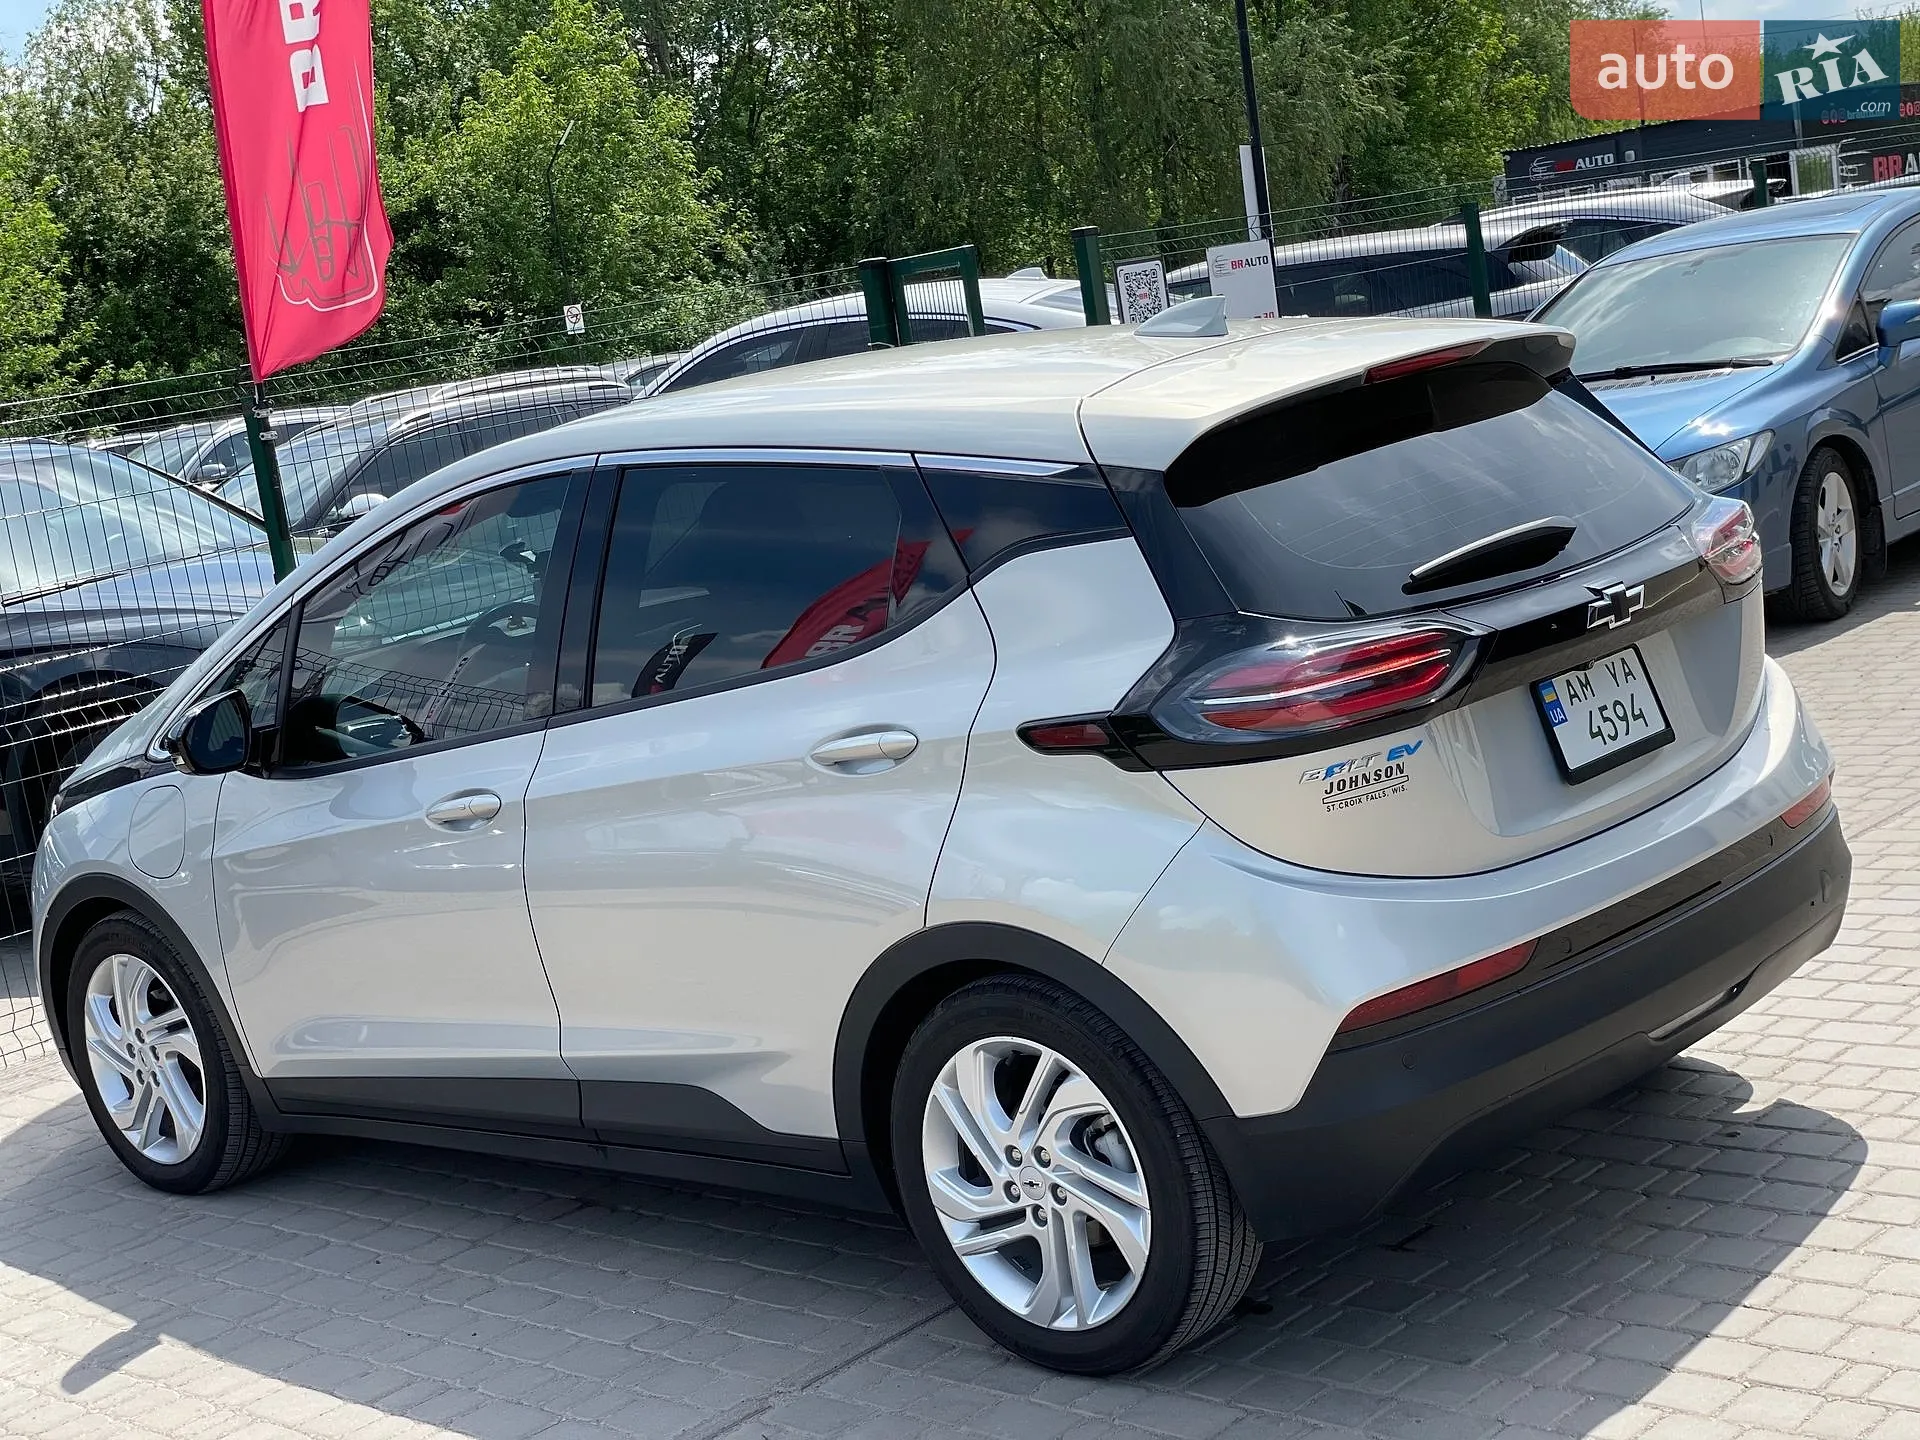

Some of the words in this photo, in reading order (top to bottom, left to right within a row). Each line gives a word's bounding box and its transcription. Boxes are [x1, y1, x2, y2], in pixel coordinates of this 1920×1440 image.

[1231, 255, 1269, 270] BRAUTO
[1565, 672, 1596, 706] AM
[1550, 707, 1567, 724] UA
[1588, 693, 1649, 746] 4594
[1387, 740, 1424, 762] EV
[1324, 762, 1406, 795] JOHNSON
